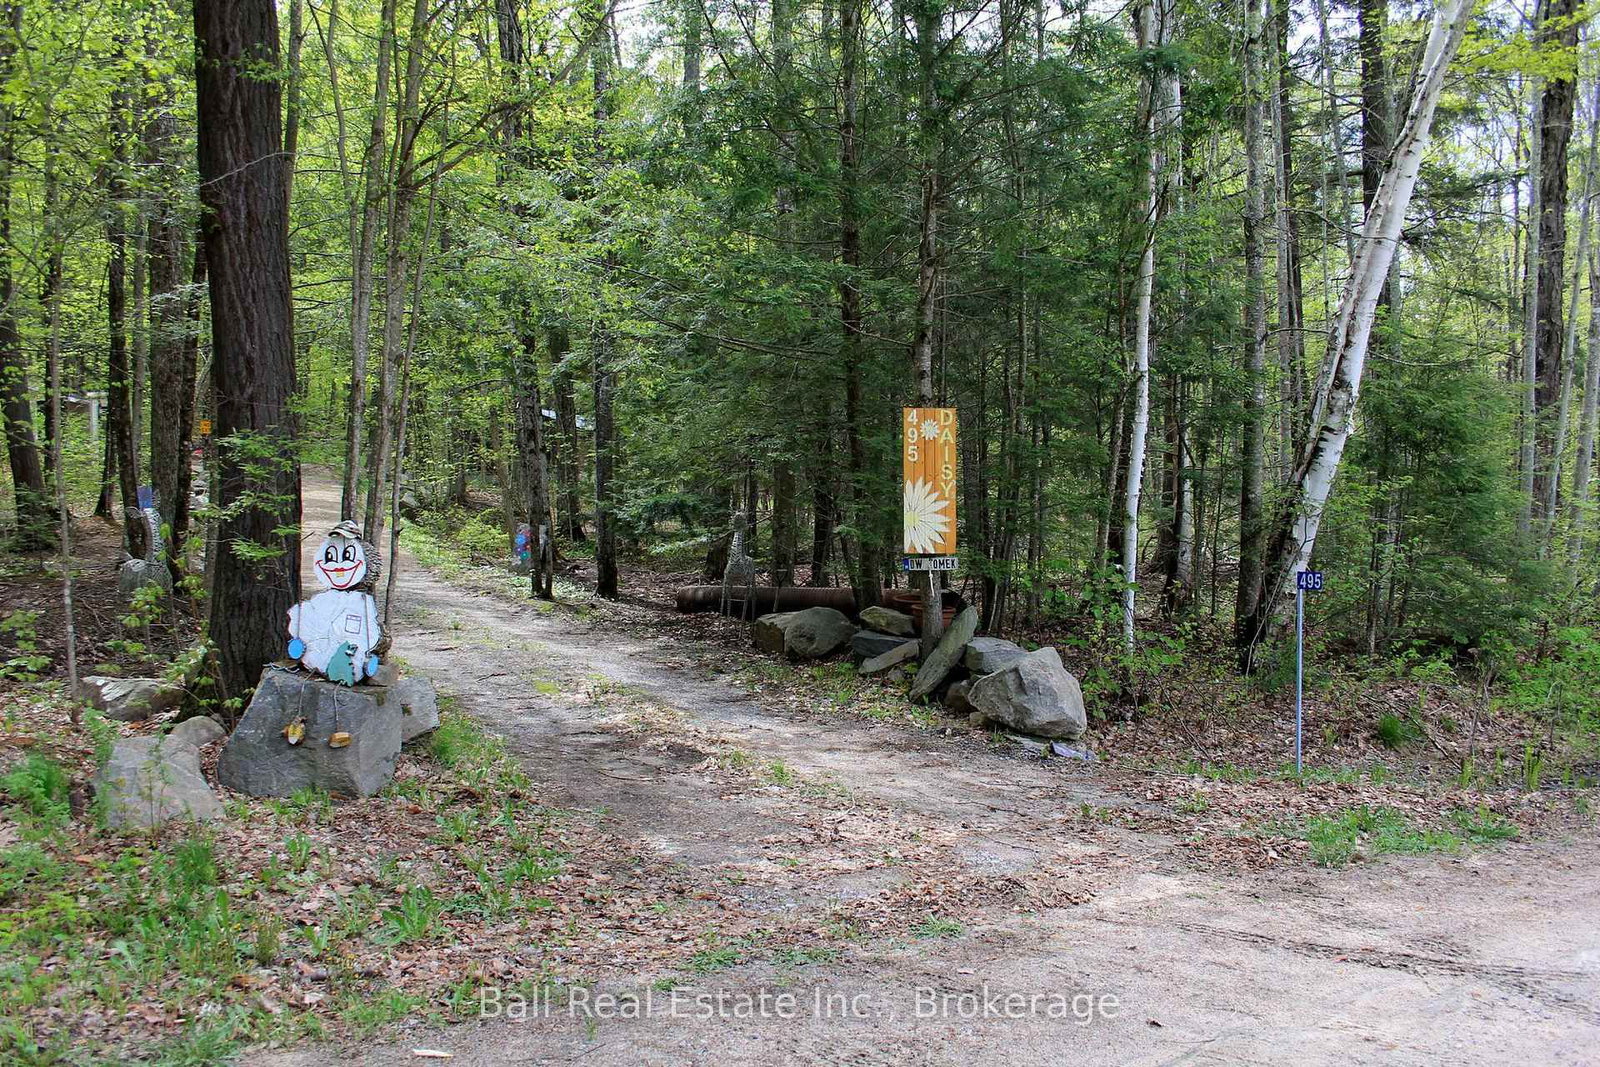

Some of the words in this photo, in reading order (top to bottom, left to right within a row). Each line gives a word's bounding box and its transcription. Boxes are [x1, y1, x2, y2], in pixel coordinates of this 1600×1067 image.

[907, 409, 919, 462] 495
[939, 410, 954, 498] DAISY
[1300, 573, 1321, 589] 495
